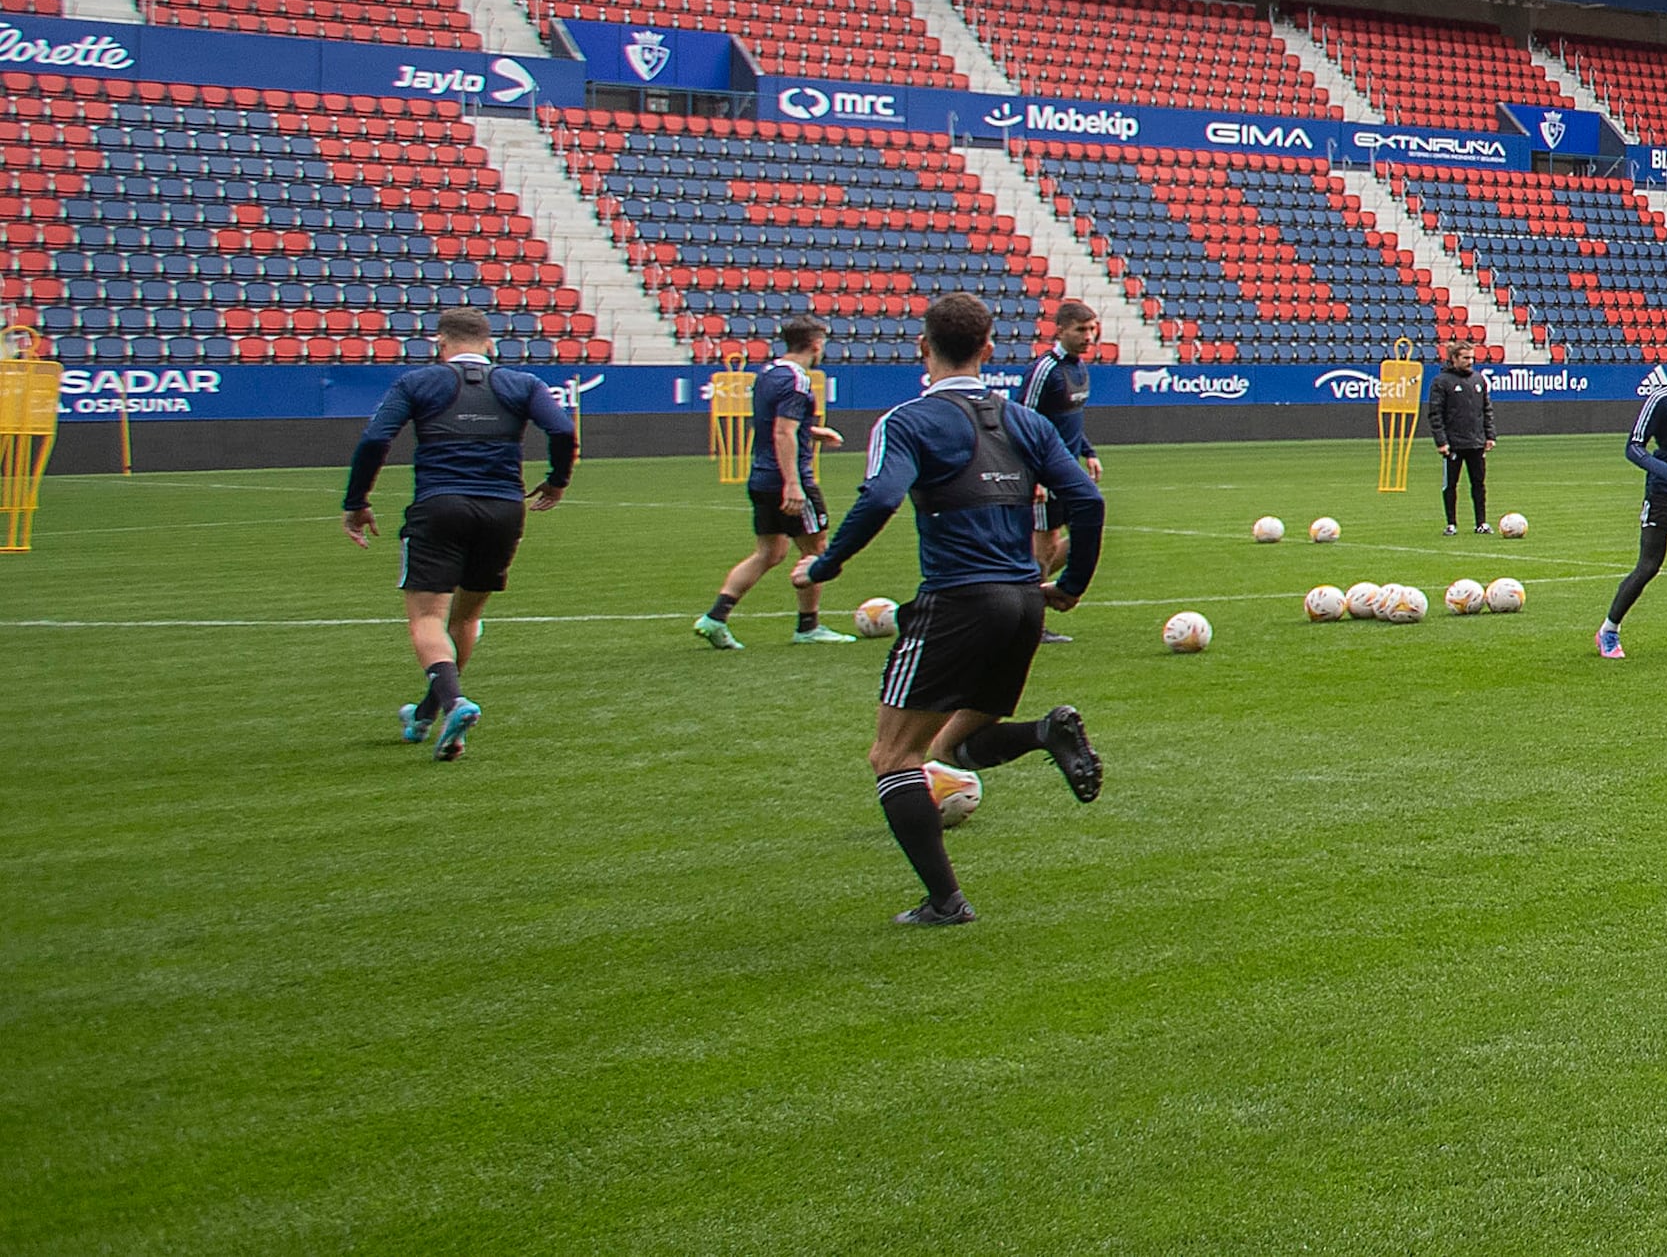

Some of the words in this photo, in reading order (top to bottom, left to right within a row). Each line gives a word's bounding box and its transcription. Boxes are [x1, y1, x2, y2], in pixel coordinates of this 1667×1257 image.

[0, 23, 135, 70] lorette
[392, 65, 487, 94] Jaylo
[834, 92, 896, 116] mrc
[1026, 104, 1141, 141] Mobekip
[1205, 122, 1314, 149] GIMA
[58, 369, 222, 394] SADAR
[1481, 368, 1568, 394] SanMiguel
[73, 397, 192, 414] OSASUNA
